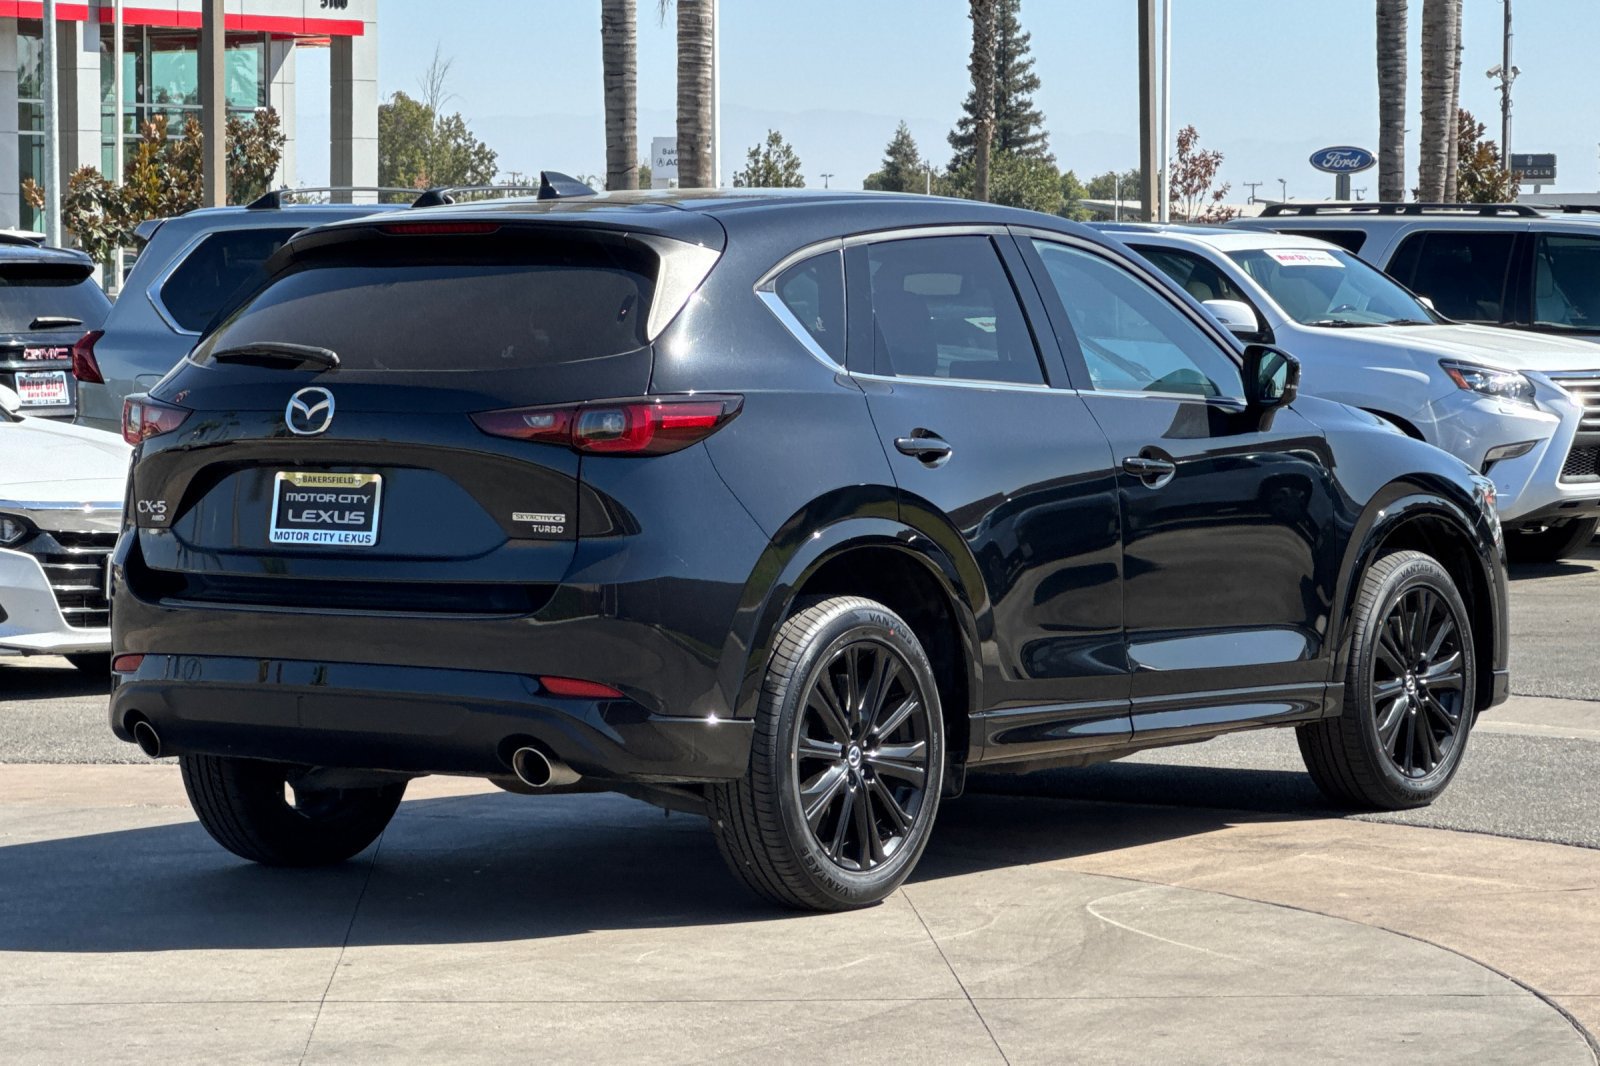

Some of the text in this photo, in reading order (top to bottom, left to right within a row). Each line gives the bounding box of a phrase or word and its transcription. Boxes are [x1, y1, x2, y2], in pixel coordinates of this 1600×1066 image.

[1322, 151, 1361, 168] Ford
[23, 347, 68, 360] GMC
[18, 379, 64, 392] Motor City
[303, 475, 354, 484] BAKERSFIELD
[286, 493, 371, 504] MOTOR CITY
[137, 500, 167, 513] CX-5
[288, 509, 365, 525] LEXUS
[532, 525, 564, 533] TURBO
[274, 531, 371, 543] MOTOR CITY LEXUS
